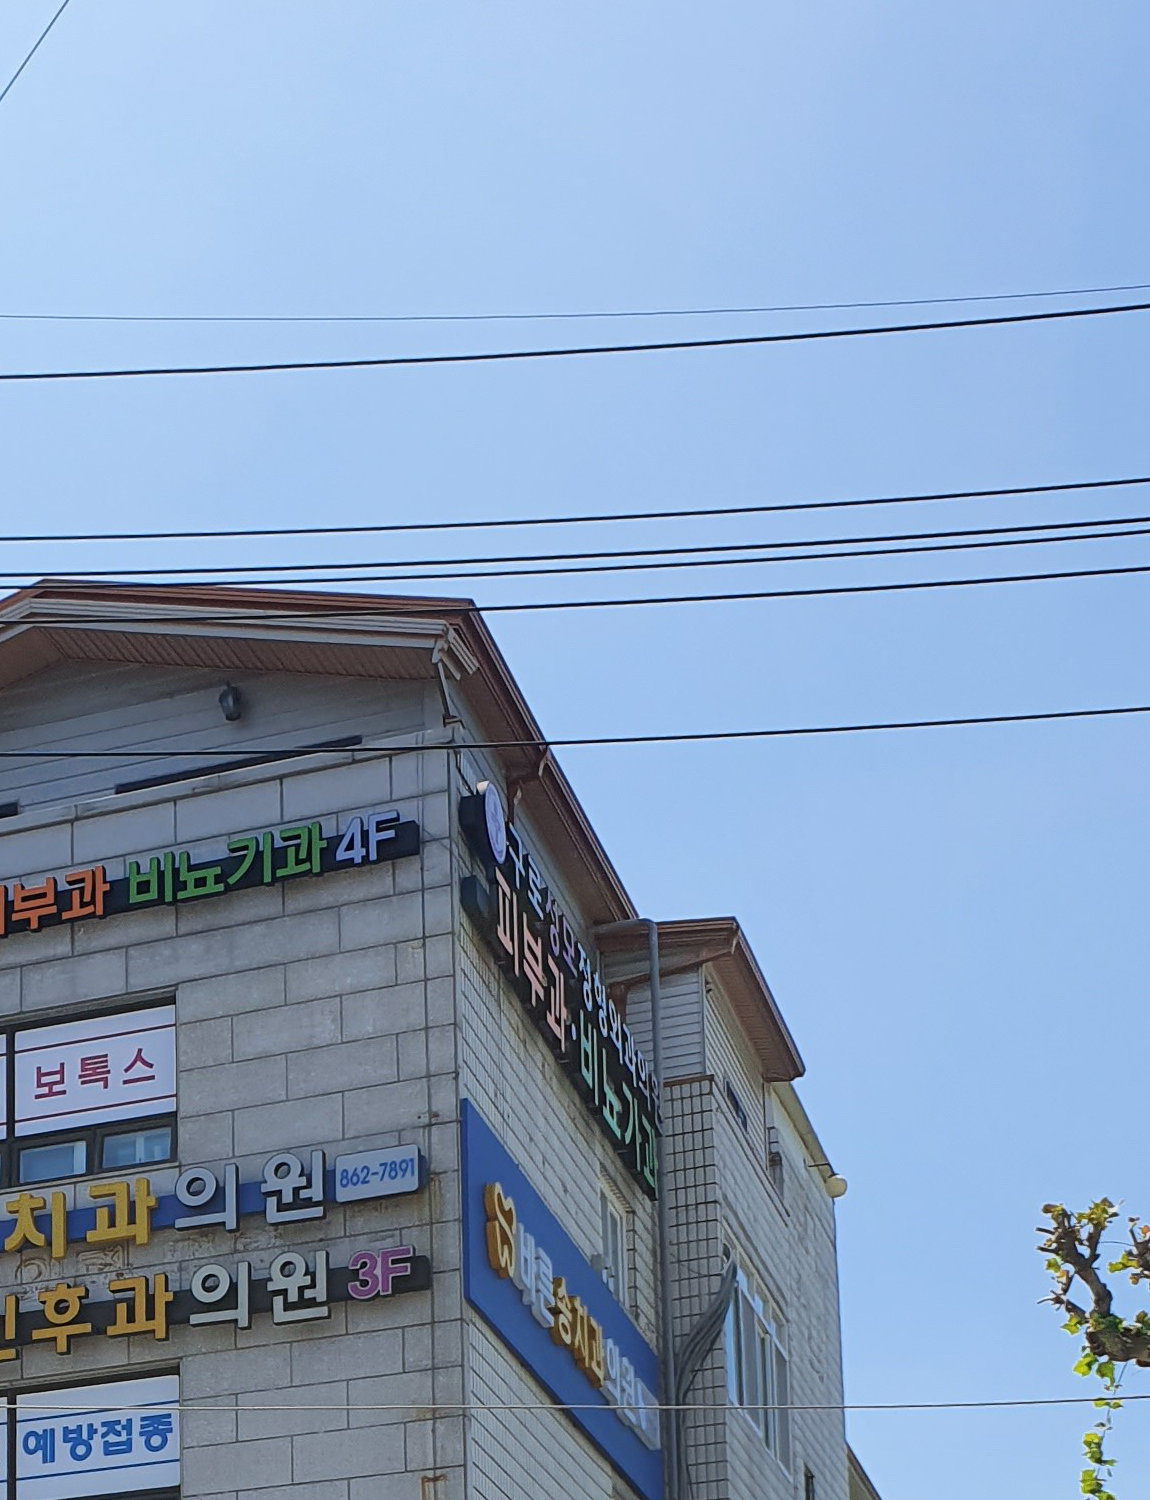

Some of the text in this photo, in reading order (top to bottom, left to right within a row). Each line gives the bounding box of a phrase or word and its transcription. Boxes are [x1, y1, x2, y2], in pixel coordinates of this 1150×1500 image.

[129, 821, 327, 903] 비뇨기과
[335, 811, 400, 865] 4F
[34, 1048, 156, 1099] 보톡스
[339, 1156, 416, 1189] 862-7891
[348, 1245, 414, 1300] 3F
[22, 1413, 173, 1464] 예방접종
